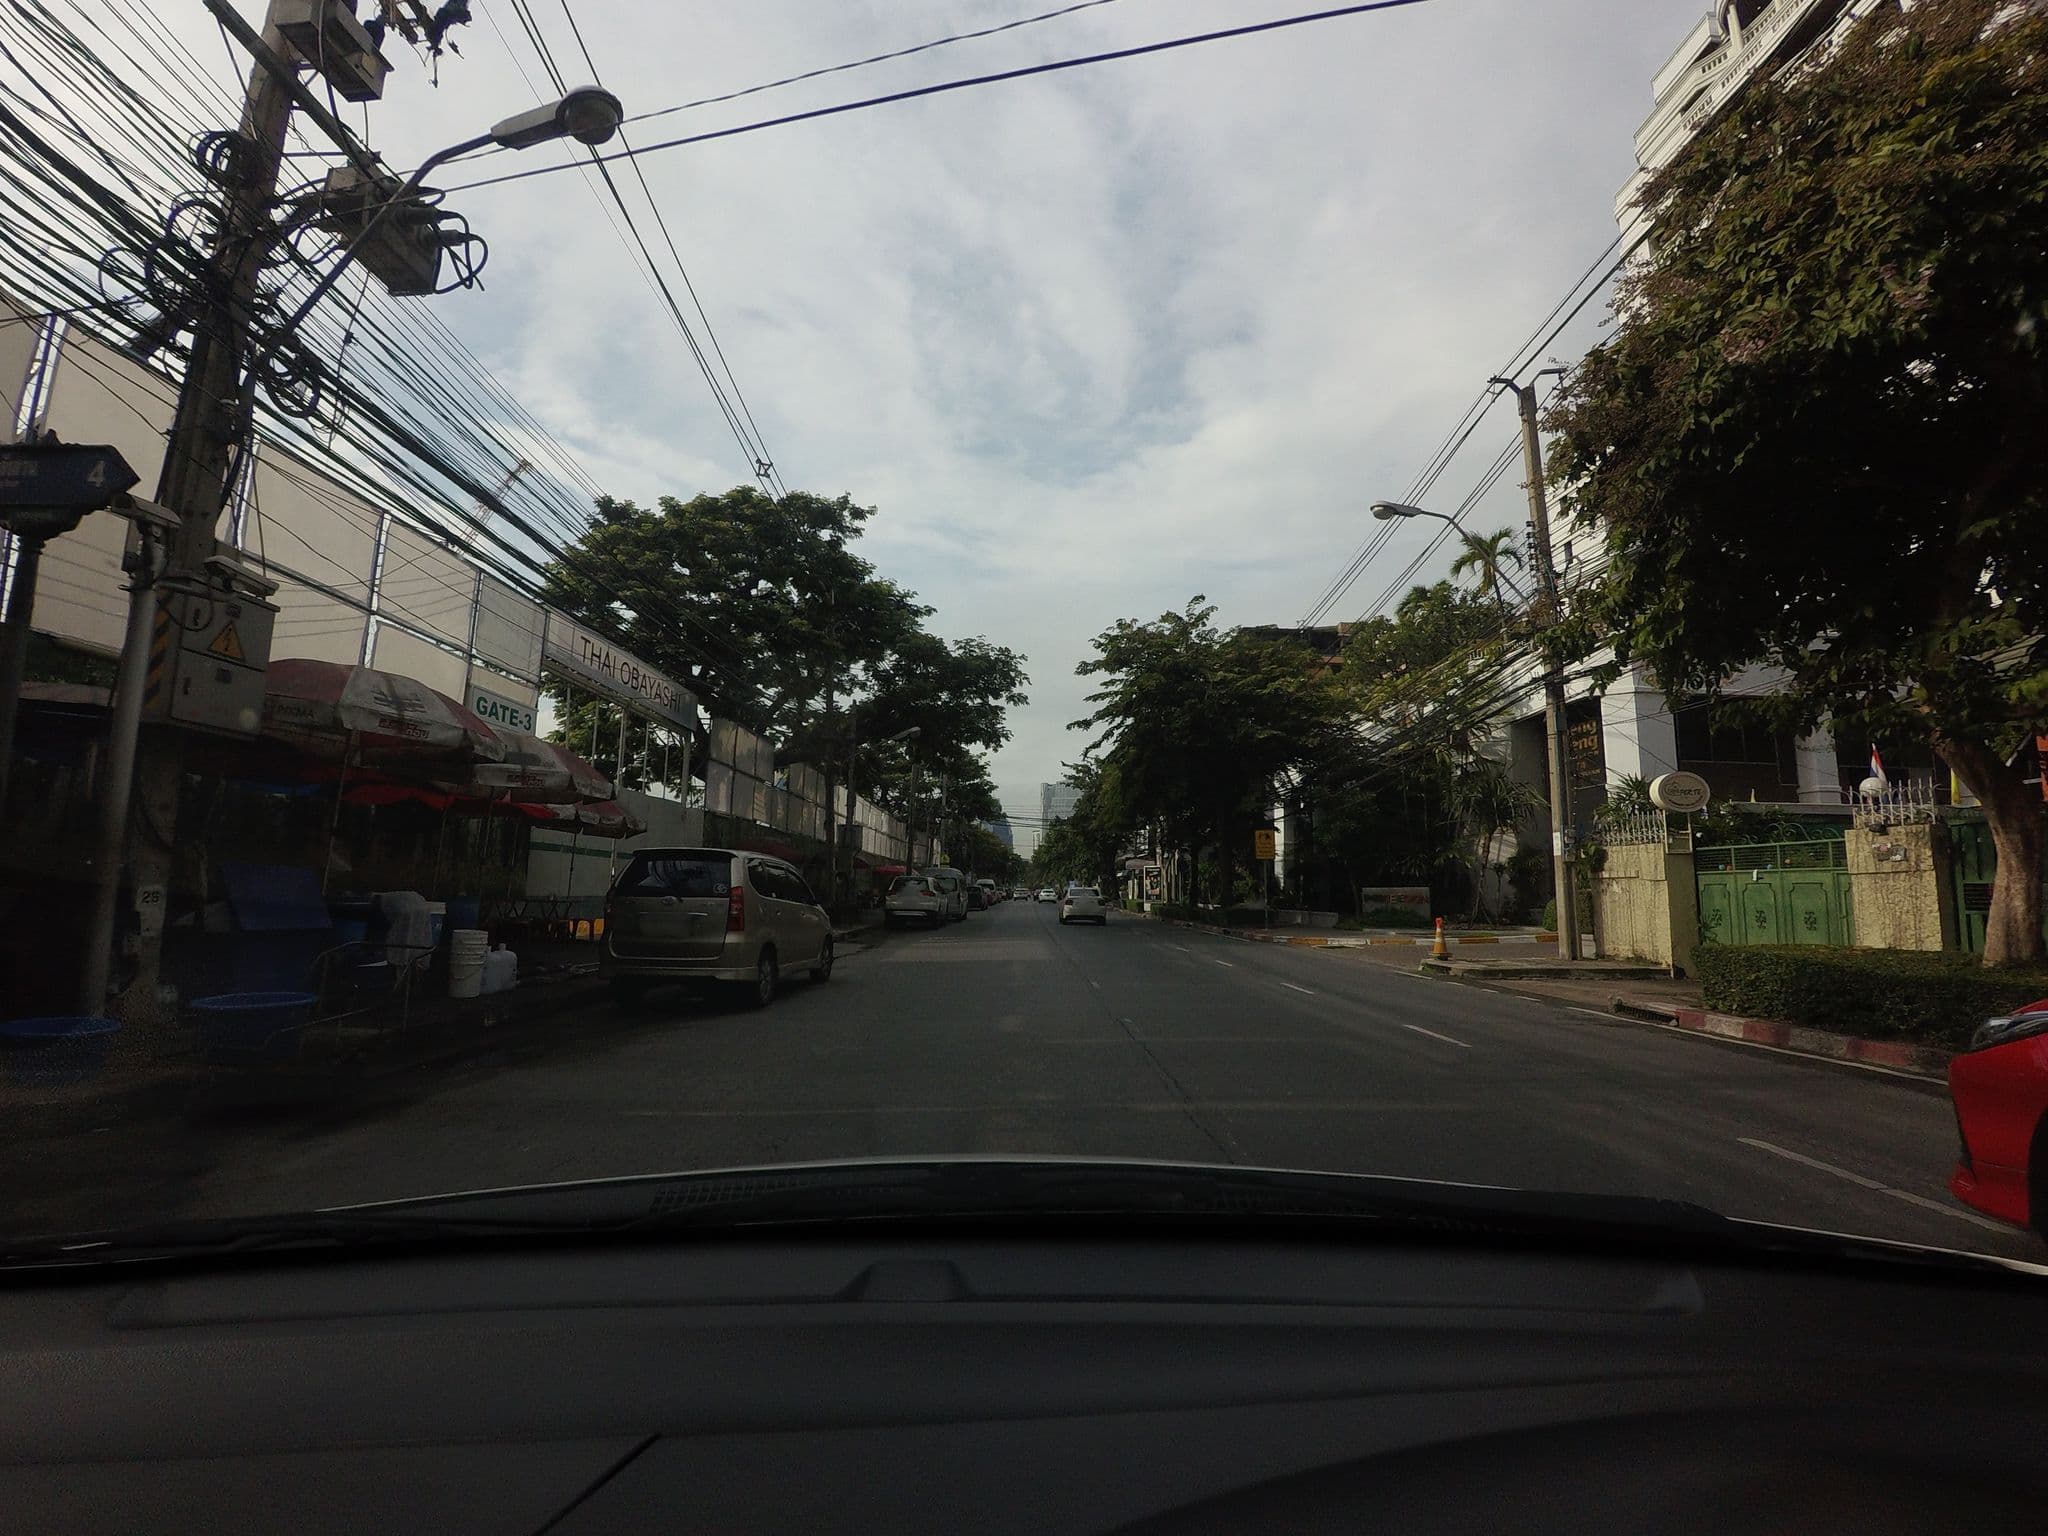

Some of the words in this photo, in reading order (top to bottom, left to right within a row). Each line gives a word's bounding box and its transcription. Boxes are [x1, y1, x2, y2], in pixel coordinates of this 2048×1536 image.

[87, 460, 105, 487] 4
[581, 636, 617, 679] THAI
[620, 661, 680, 712] OBAYASHI
[476, 696, 532, 731] GATE-3
